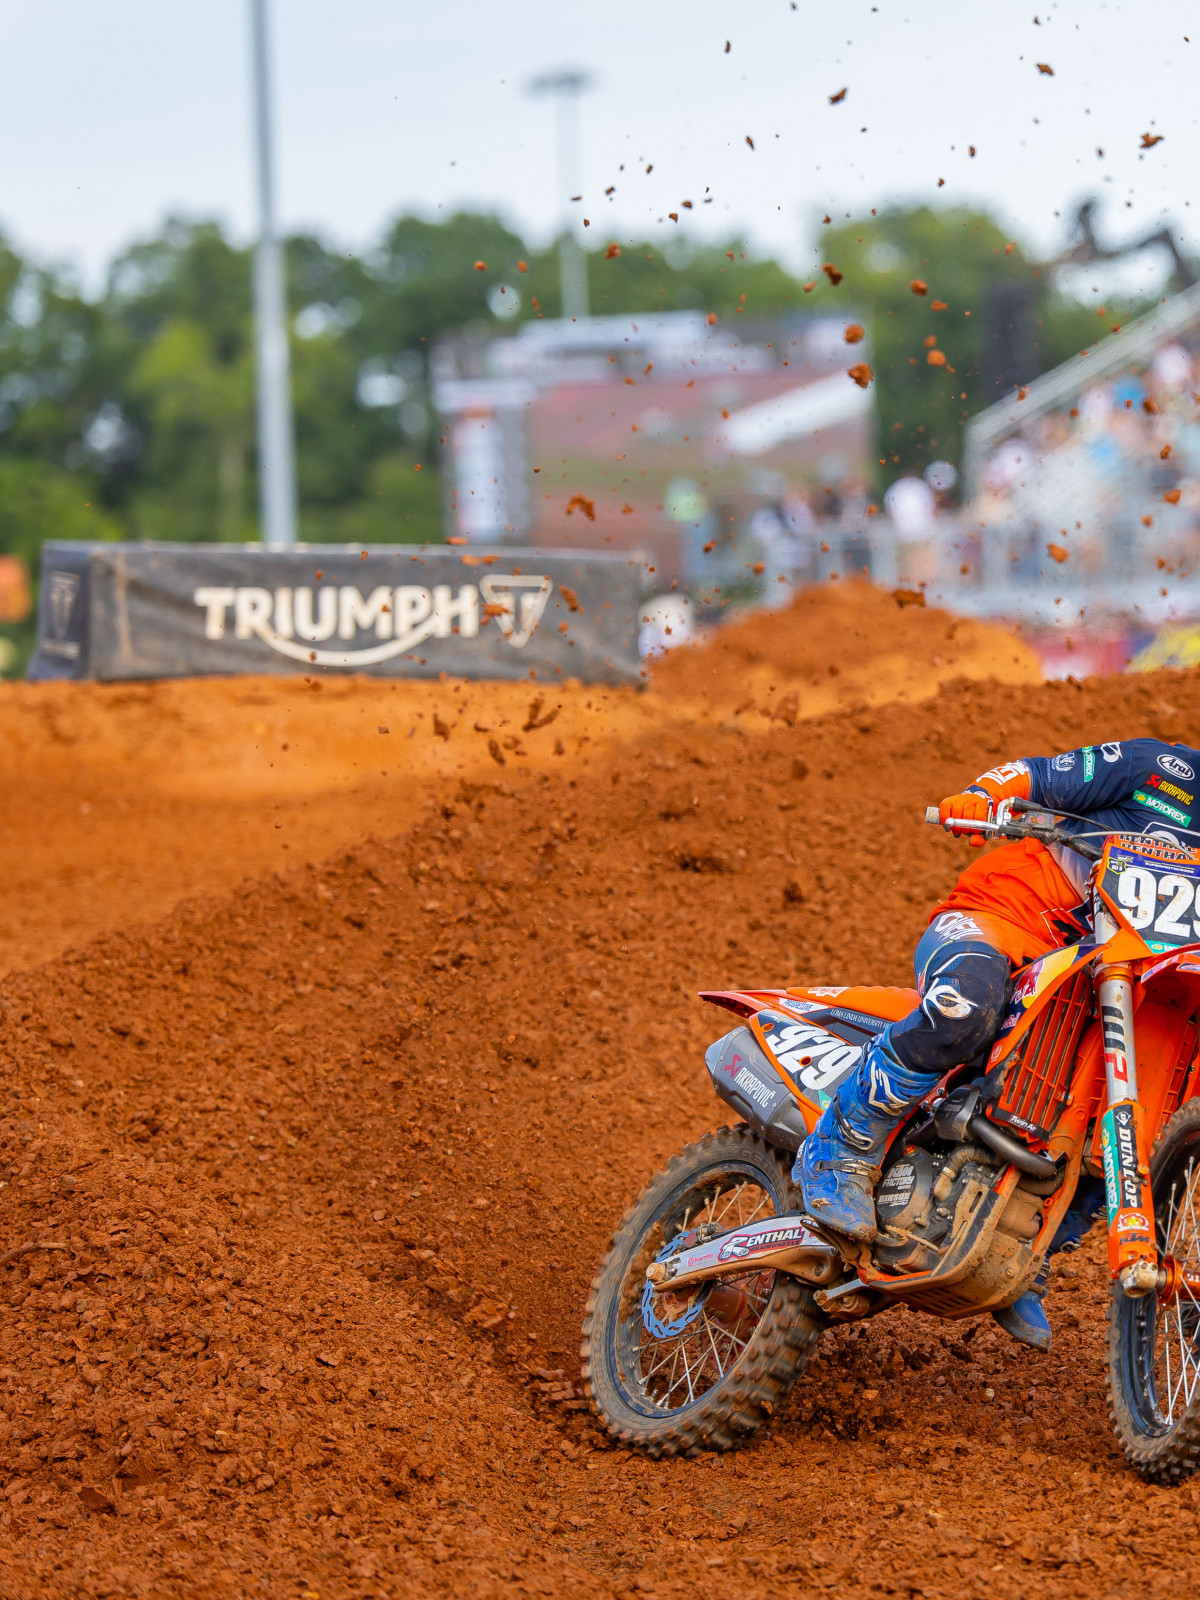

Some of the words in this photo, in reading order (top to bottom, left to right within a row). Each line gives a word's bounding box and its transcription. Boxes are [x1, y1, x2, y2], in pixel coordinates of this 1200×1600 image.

[193, 584, 480, 667] TRIUMPH
[1164, 758, 1190, 776] Arai
[1146, 797, 1187, 824] MOTOREX
[1121, 842, 1196, 861] RENTHA
[765, 1024, 863, 1091] 929
[1010, 1114, 1028, 1128] Twin
[1026, 1122, 1037, 1132] Air
[1118, 1126, 1138, 1209] DUNLOP
[882, 1175, 915, 1188] FACTORY
[1103, 1145, 1118, 1215] MOTOREX
[1120, 1233, 1150, 1245] KTM
